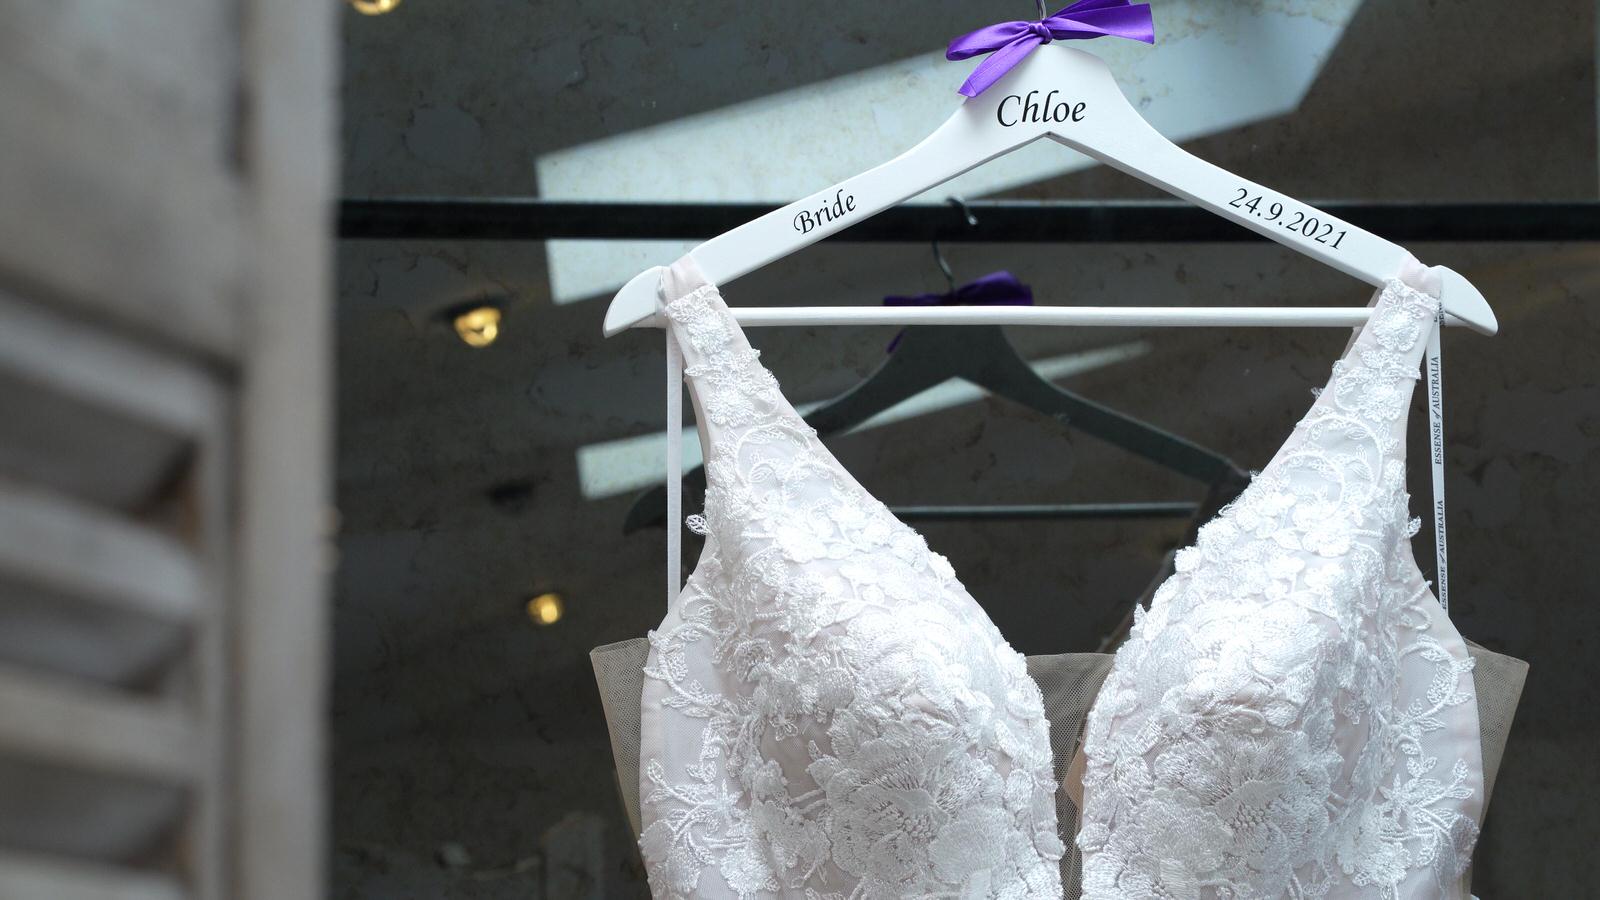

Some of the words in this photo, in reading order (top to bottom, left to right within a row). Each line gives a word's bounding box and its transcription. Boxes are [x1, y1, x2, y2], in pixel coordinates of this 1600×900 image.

[996, 90, 1086, 127] Chloe
[793, 188, 856, 234] Bride
[1228, 187, 1347, 249] 24.9.2021
[1431, 356, 1440, 409] AUSTRALIA
[1432, 409, 1442, 419] of
[1433, 422, 1442, 465] ESSENSE
[1437, 500, 1446, 553] AUSTRALIA
[1440, 566, 1448, 610] ESSENSE
